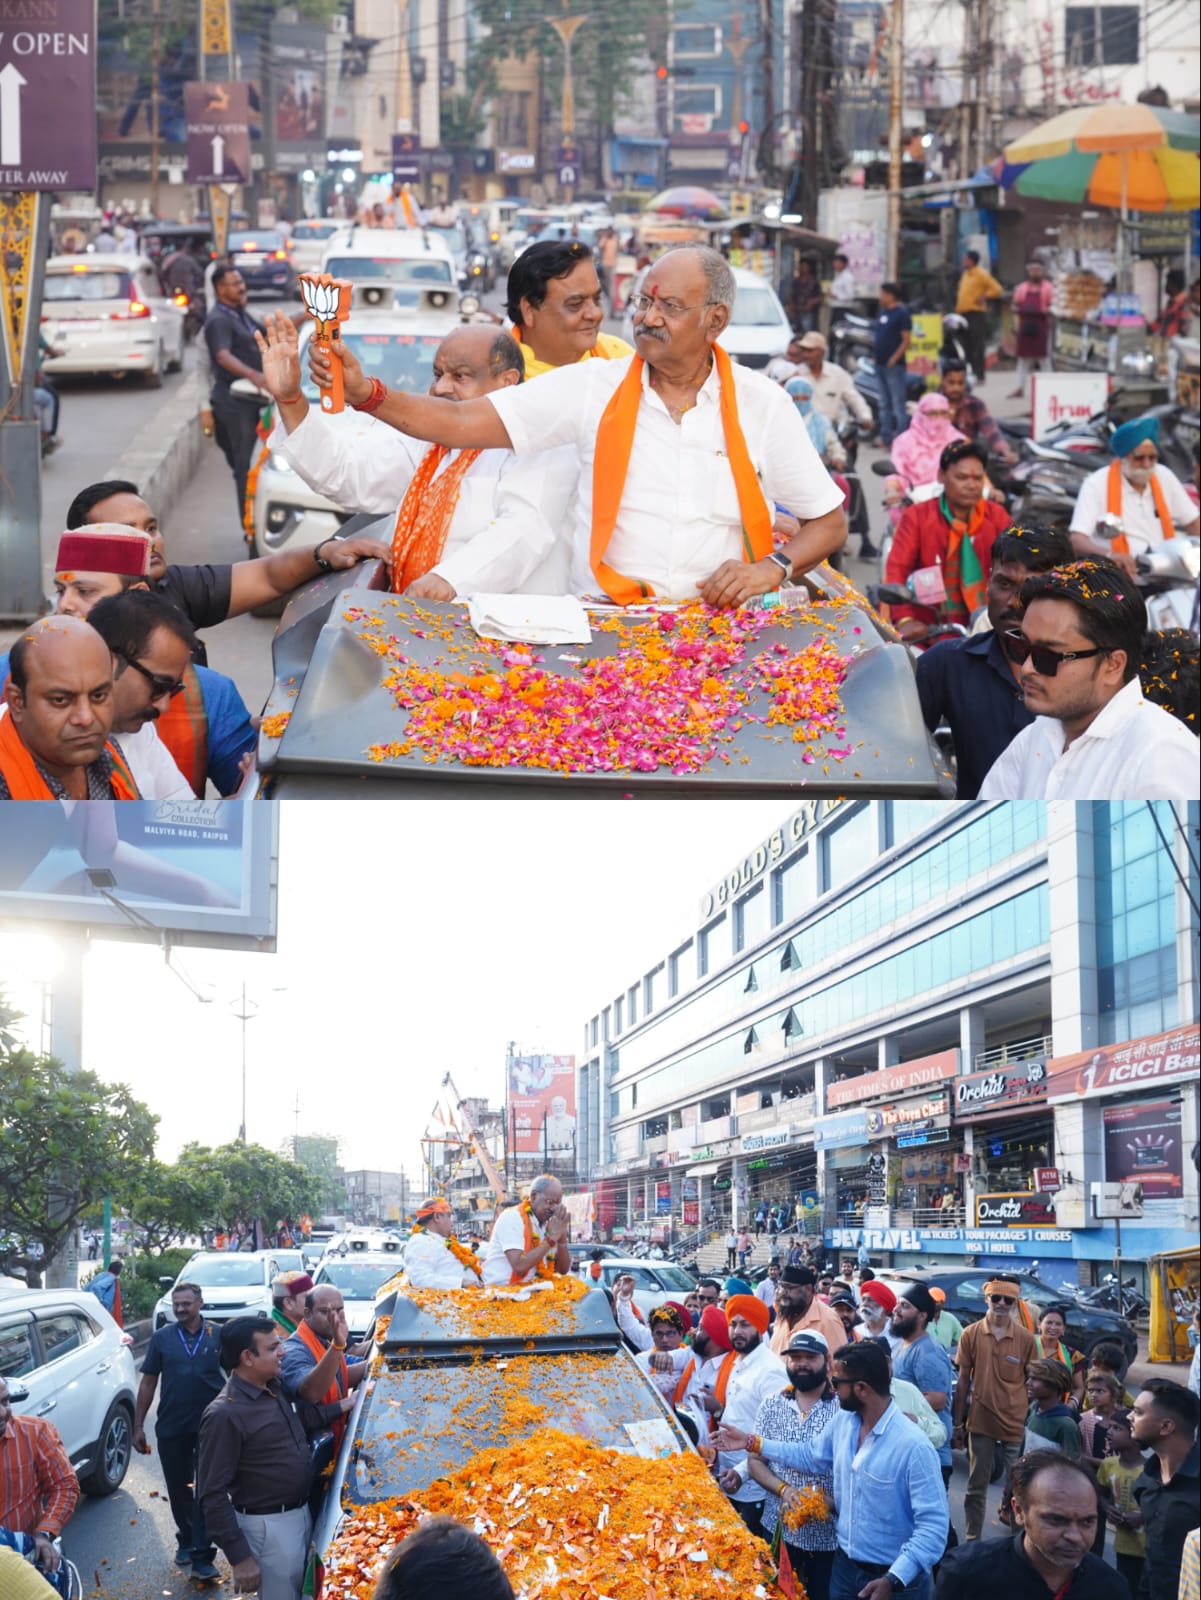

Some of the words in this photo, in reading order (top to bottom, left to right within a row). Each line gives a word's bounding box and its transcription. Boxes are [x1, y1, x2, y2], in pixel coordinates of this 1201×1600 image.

[12, 31, 89, 55] OPEN
[187, 123, 216, 135] NOW
[218, 123, 248, 135] OPEN
[27, 170, 69, 184] AWAY
[170, 814, 217, 826] COLLECTION
[144, 825, 176, 836] MALVIYA
[202, 831, 229, 841] RAIPUR
[717, 828, 785, 905] GOLD'S
[1108, 1058, 1161, 1083] ICICI
[835, 1090, 855, 1104] THE
[857, 1081, 889, 1099] TIMES
[890, 1076, 906, 1090] OF
[908, 1066, 944, 1084] INDIA
[957, 1075, 1006, 1102] Orchid
[1041, 1171, 1057, 1180] ATM
[978, 1198, 1021, 1219] Orchid
[832, 1229, 860, 1248] DEV
[861, 1229, 922, 1249] TRAVEL
[965, 1230, 985, 1240] TOUR
[985, 1230, 1027, 1241] PACKAGES
[1034, 1230, 1072, 1242] CRUISES
[991, 1243, 1016, 1253] HOTEL
